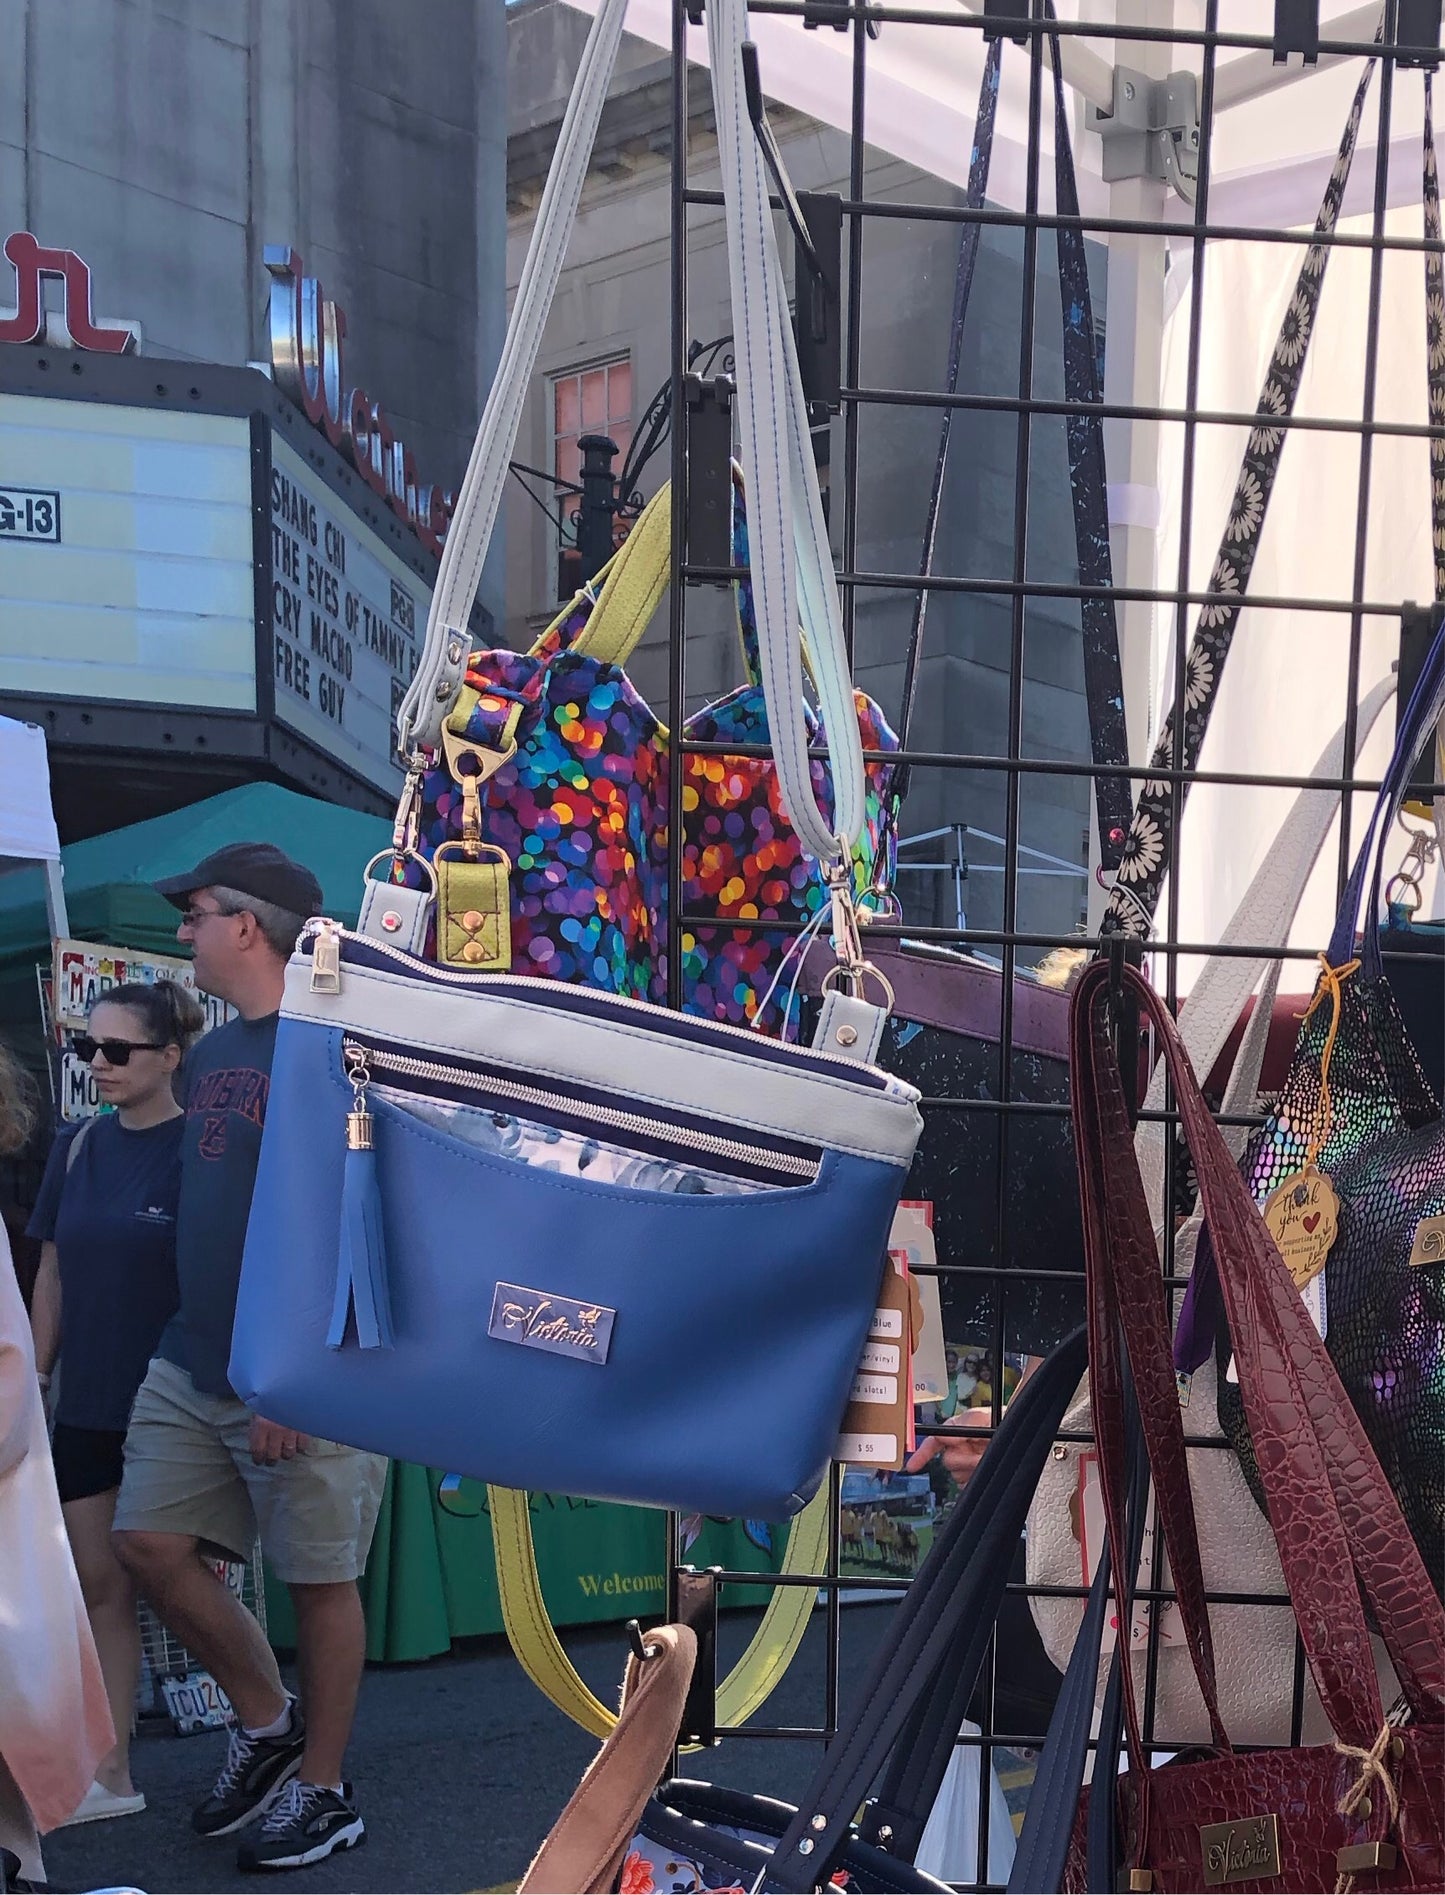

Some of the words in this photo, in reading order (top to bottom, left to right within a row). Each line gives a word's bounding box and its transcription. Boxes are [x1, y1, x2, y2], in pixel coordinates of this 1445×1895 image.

[272, 467, 318, 547] SHANG
[324, 521, 346, 575] CHI
[272, 523, 300, 586] THE
[306, 553, 339, 619] EYES
[345, 591, 360, 636] OF
[363, 606, 406, 674] TAMMY
[274, 580, 301, 639] CRY
[310, 611, 353, 682] MACHO
[275, 634, 310, 700] FREE
[319, 672, 345, 725] GUY
[1276, 1211, 1307, 1241] you
[874, 1317, 892, 1328] Blue
[865, 1444, 874, 1452] 55
[578, 1573, 665, 1597] Welcome
